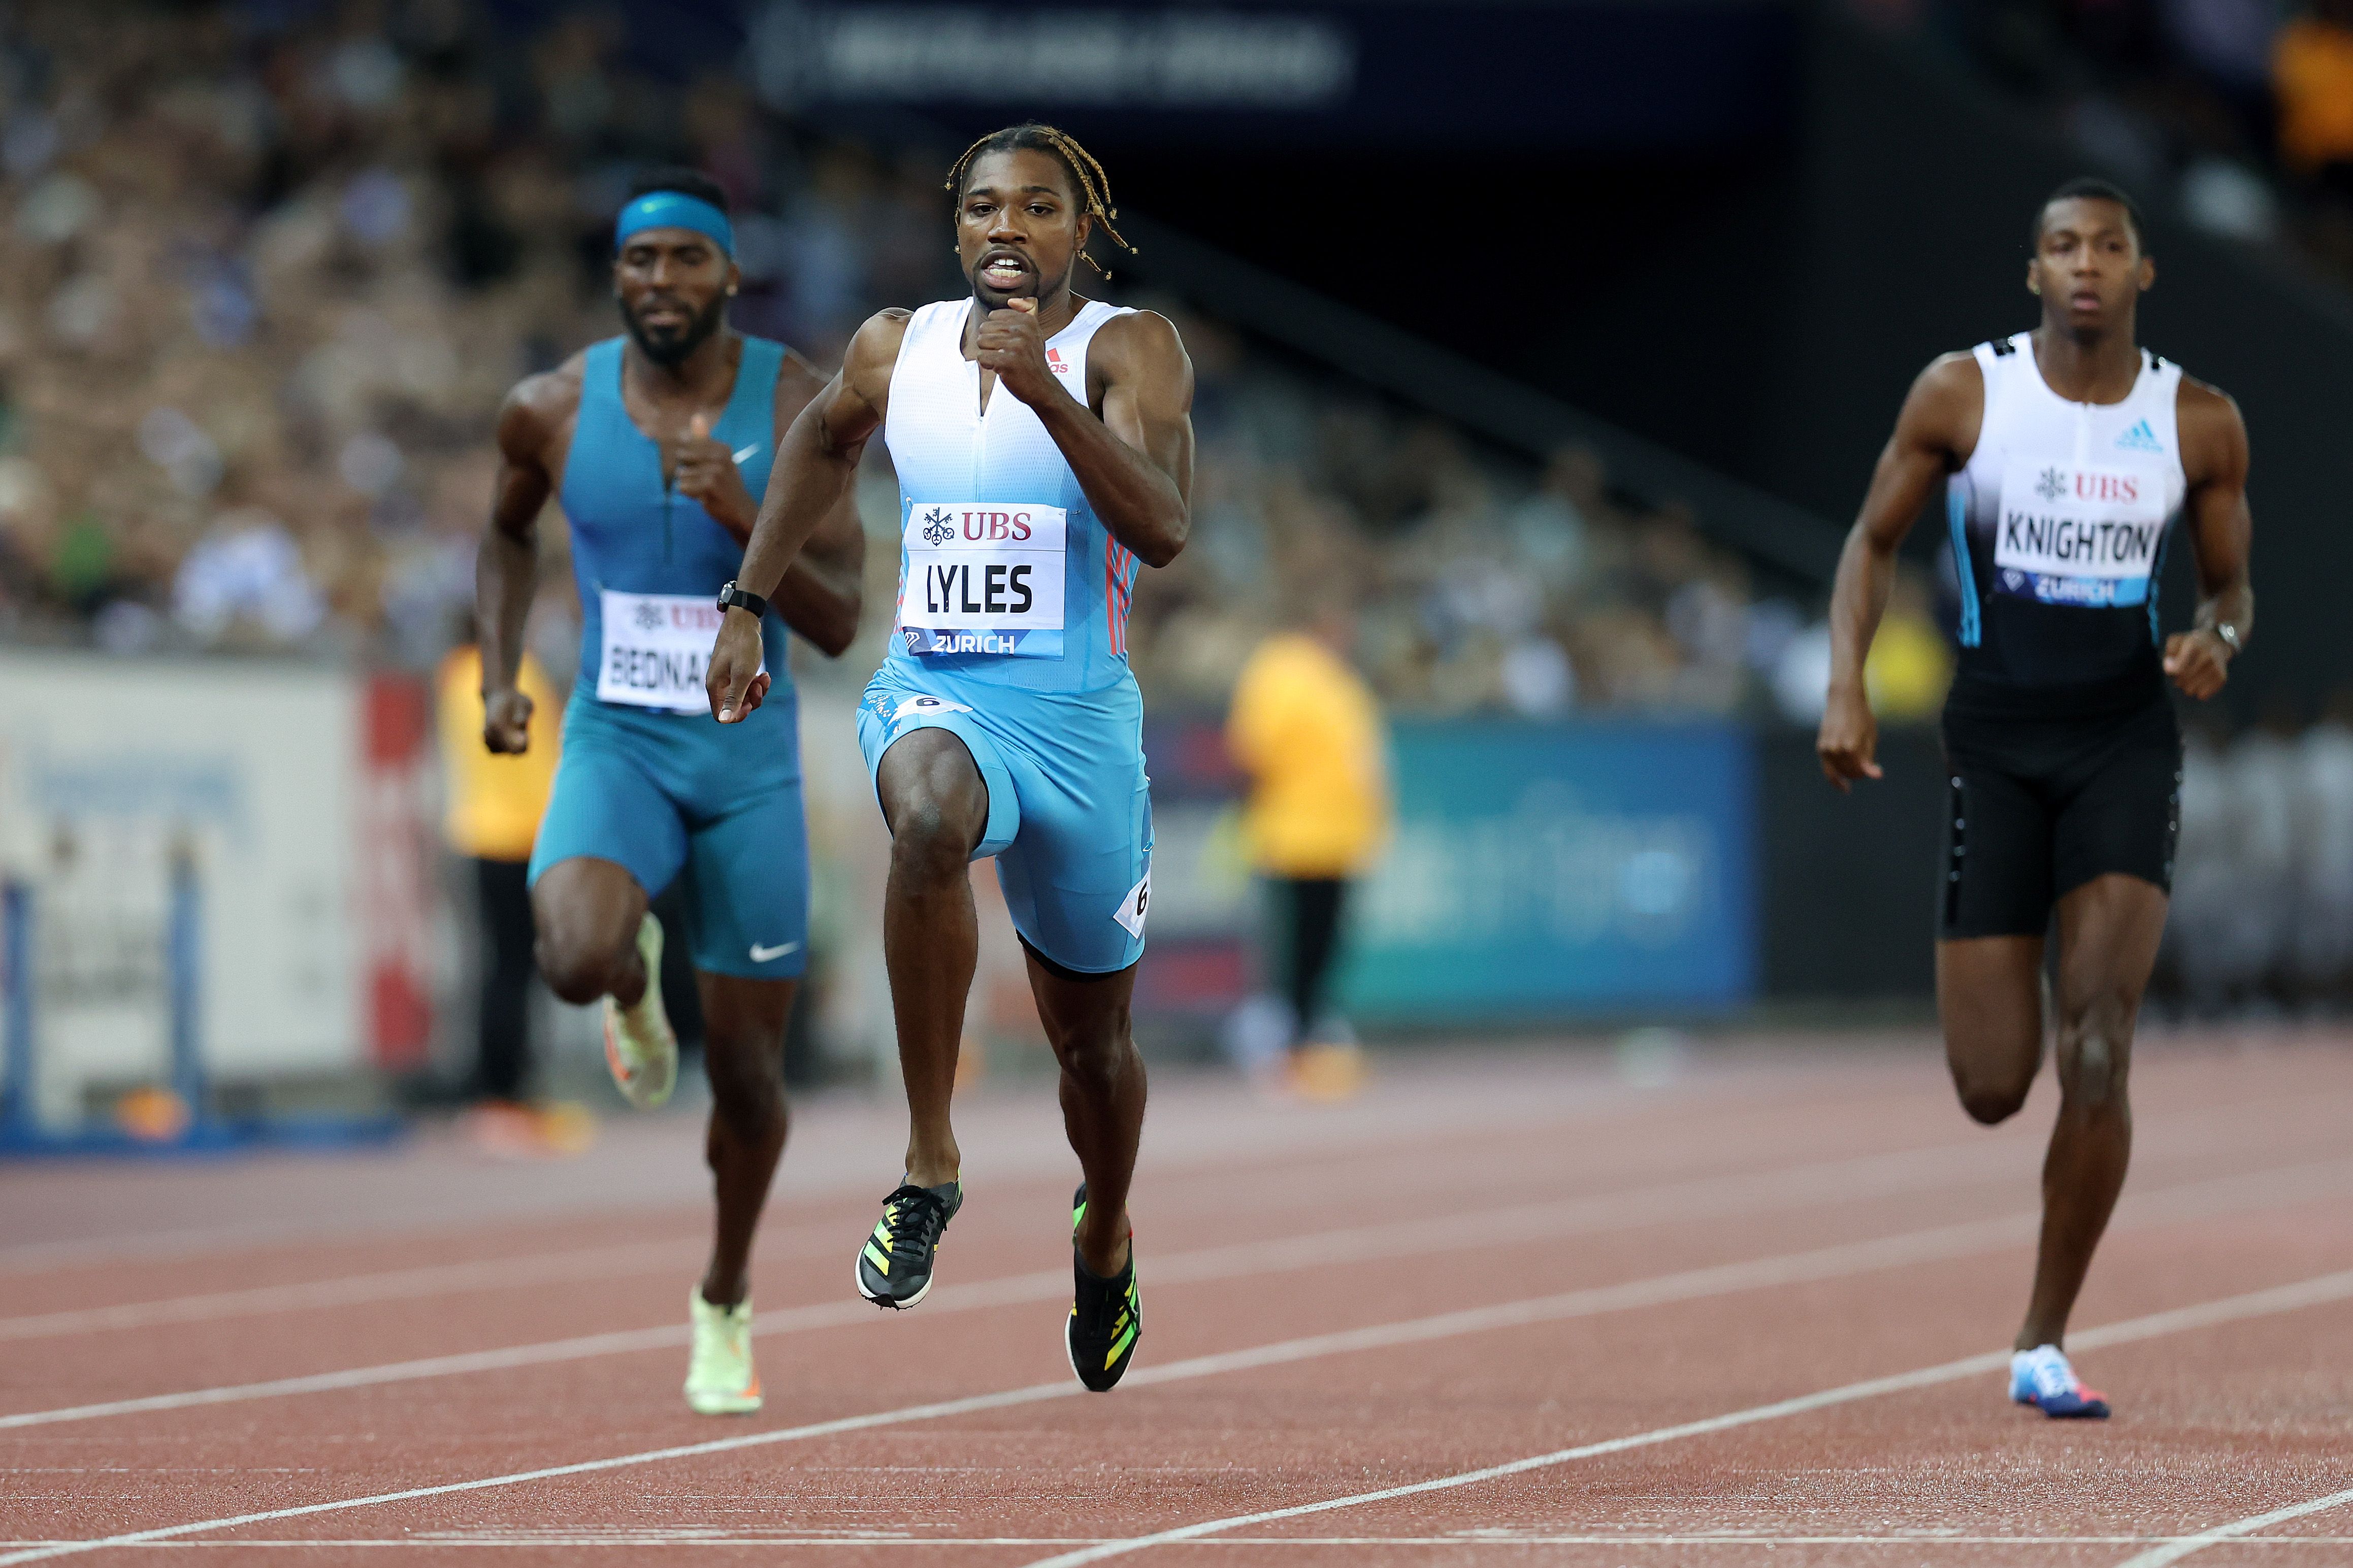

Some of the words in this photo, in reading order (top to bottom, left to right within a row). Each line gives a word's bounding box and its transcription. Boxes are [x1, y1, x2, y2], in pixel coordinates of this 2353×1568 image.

[2074, 473, 2138, 503] UBS
[962, 512, 1032, 541] UBS
[2005, 511, 2154, 563] KNIGHTON
[927, 565, 1032, 613] LYLES
[672, 605, 724, 629] UB
[931, 635, 1015, 654] ZURICH
[612, 646, 712, 690] BEDNA
[916, 697, 940, 706] 6
[1137, 881, 1148, 916] 6
